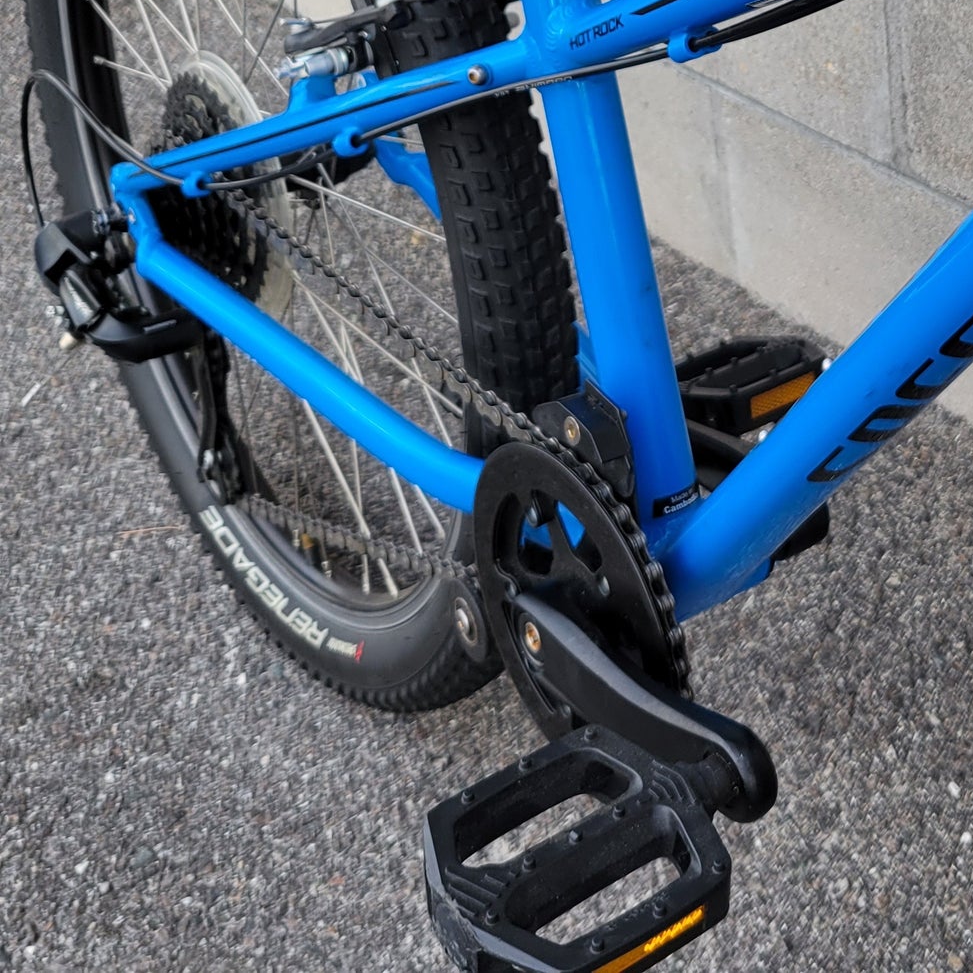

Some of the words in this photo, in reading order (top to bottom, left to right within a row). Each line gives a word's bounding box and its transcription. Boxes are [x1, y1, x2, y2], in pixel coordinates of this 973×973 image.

[569, 27, 592, 50] HOT
[593, 14, 625, 38] ROCK
[199, 505, 329, 650] RENEGADE
